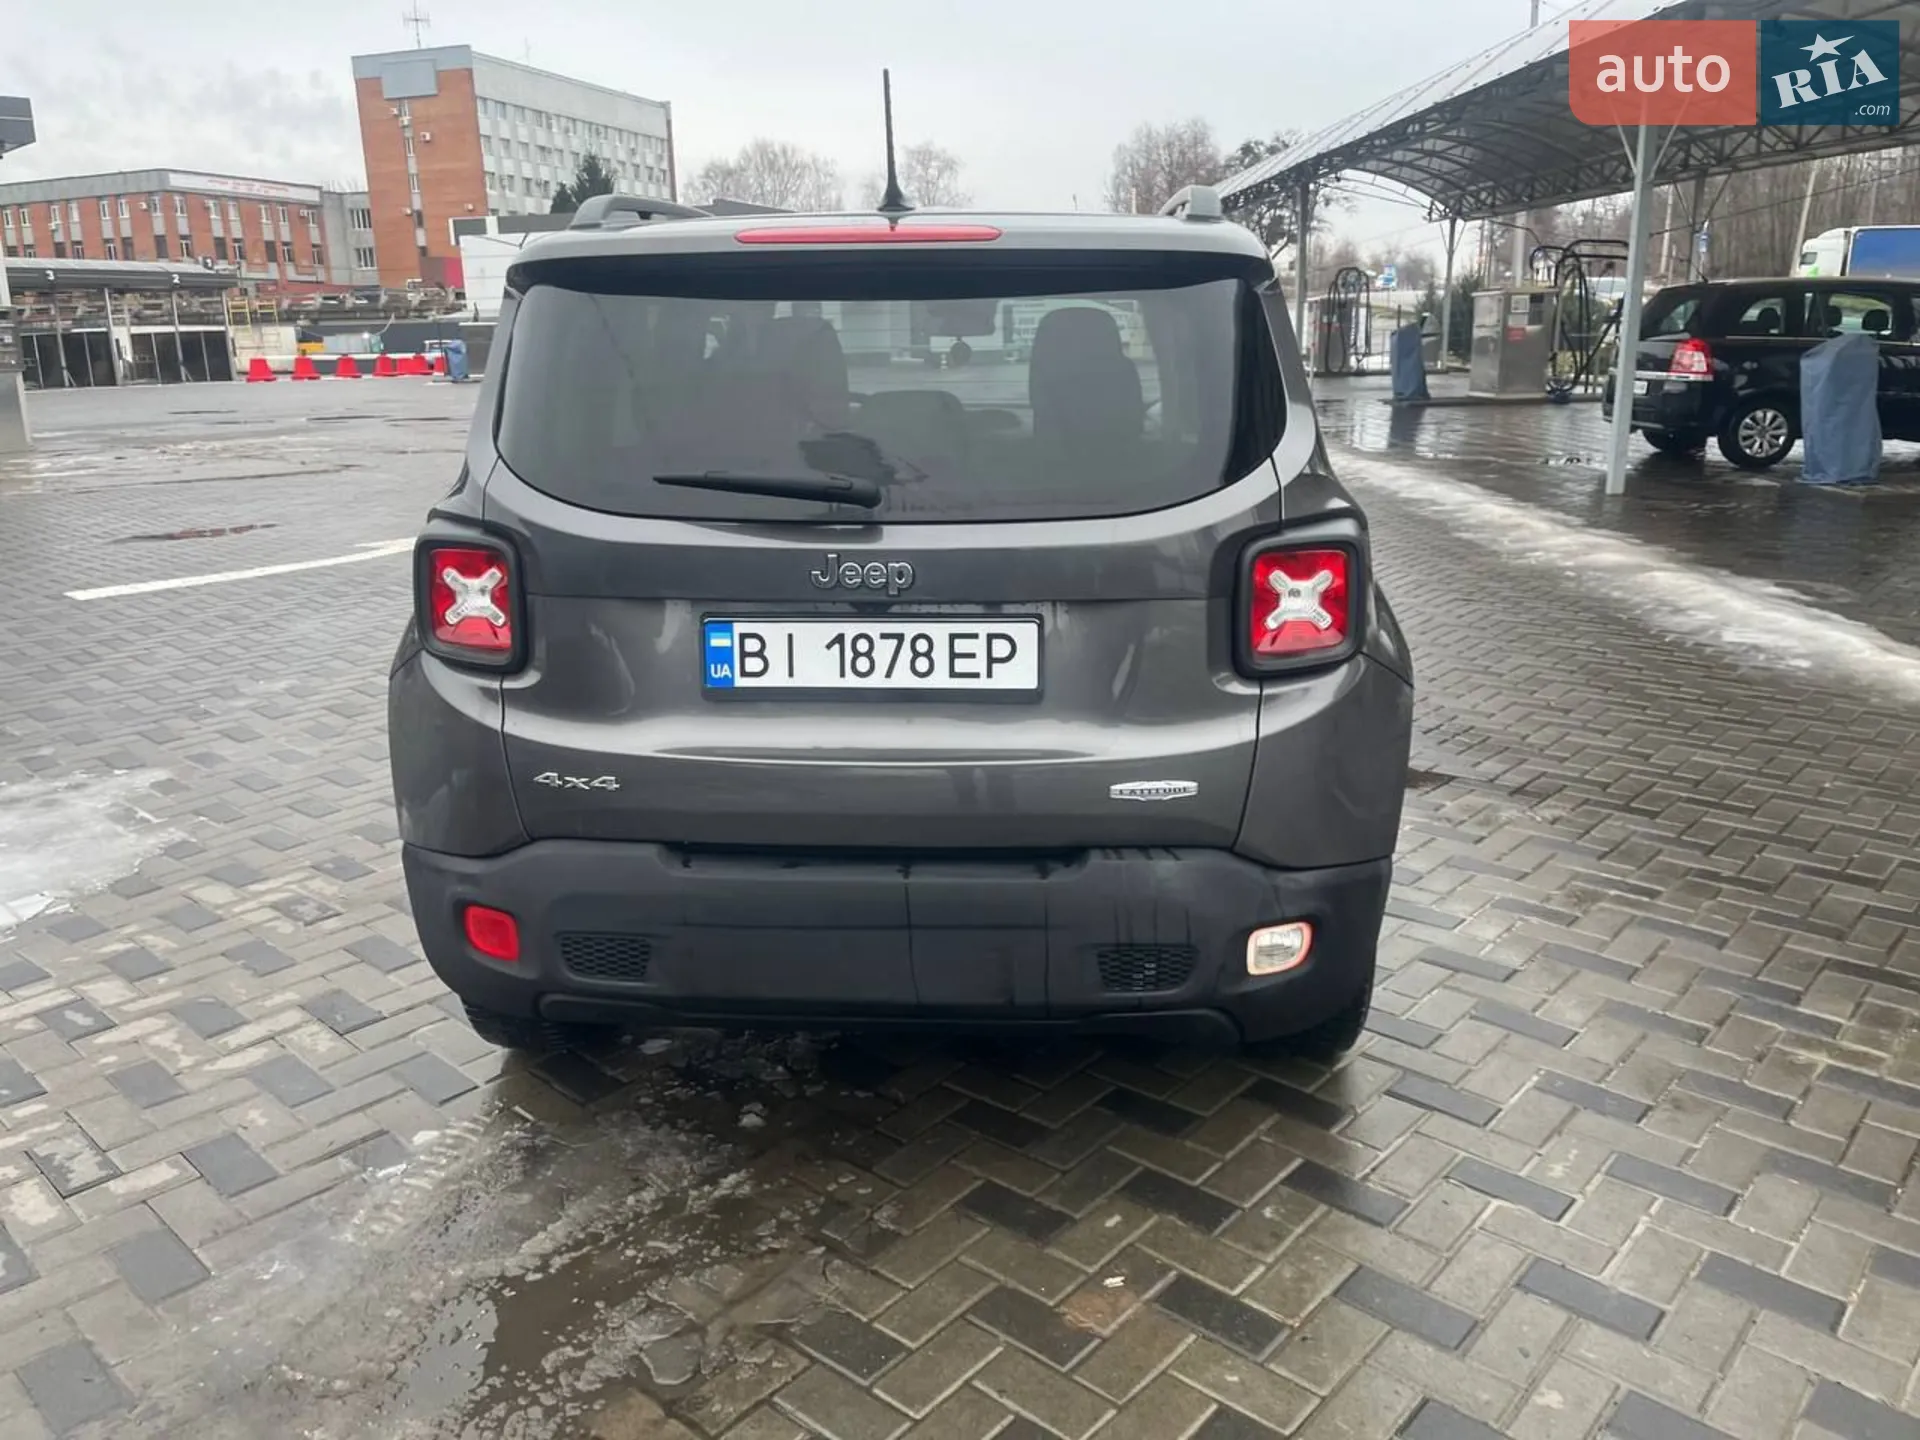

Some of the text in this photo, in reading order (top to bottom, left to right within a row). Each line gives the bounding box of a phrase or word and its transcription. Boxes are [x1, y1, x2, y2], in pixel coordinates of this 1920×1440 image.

[811, 554, 913, 595] Jeep
[825, 632, 935, 679] 1878
[948, 632, 1017, 679] EP
[710, 663, 732, 679] UA
[533, 772, 620, 791] 4x4
